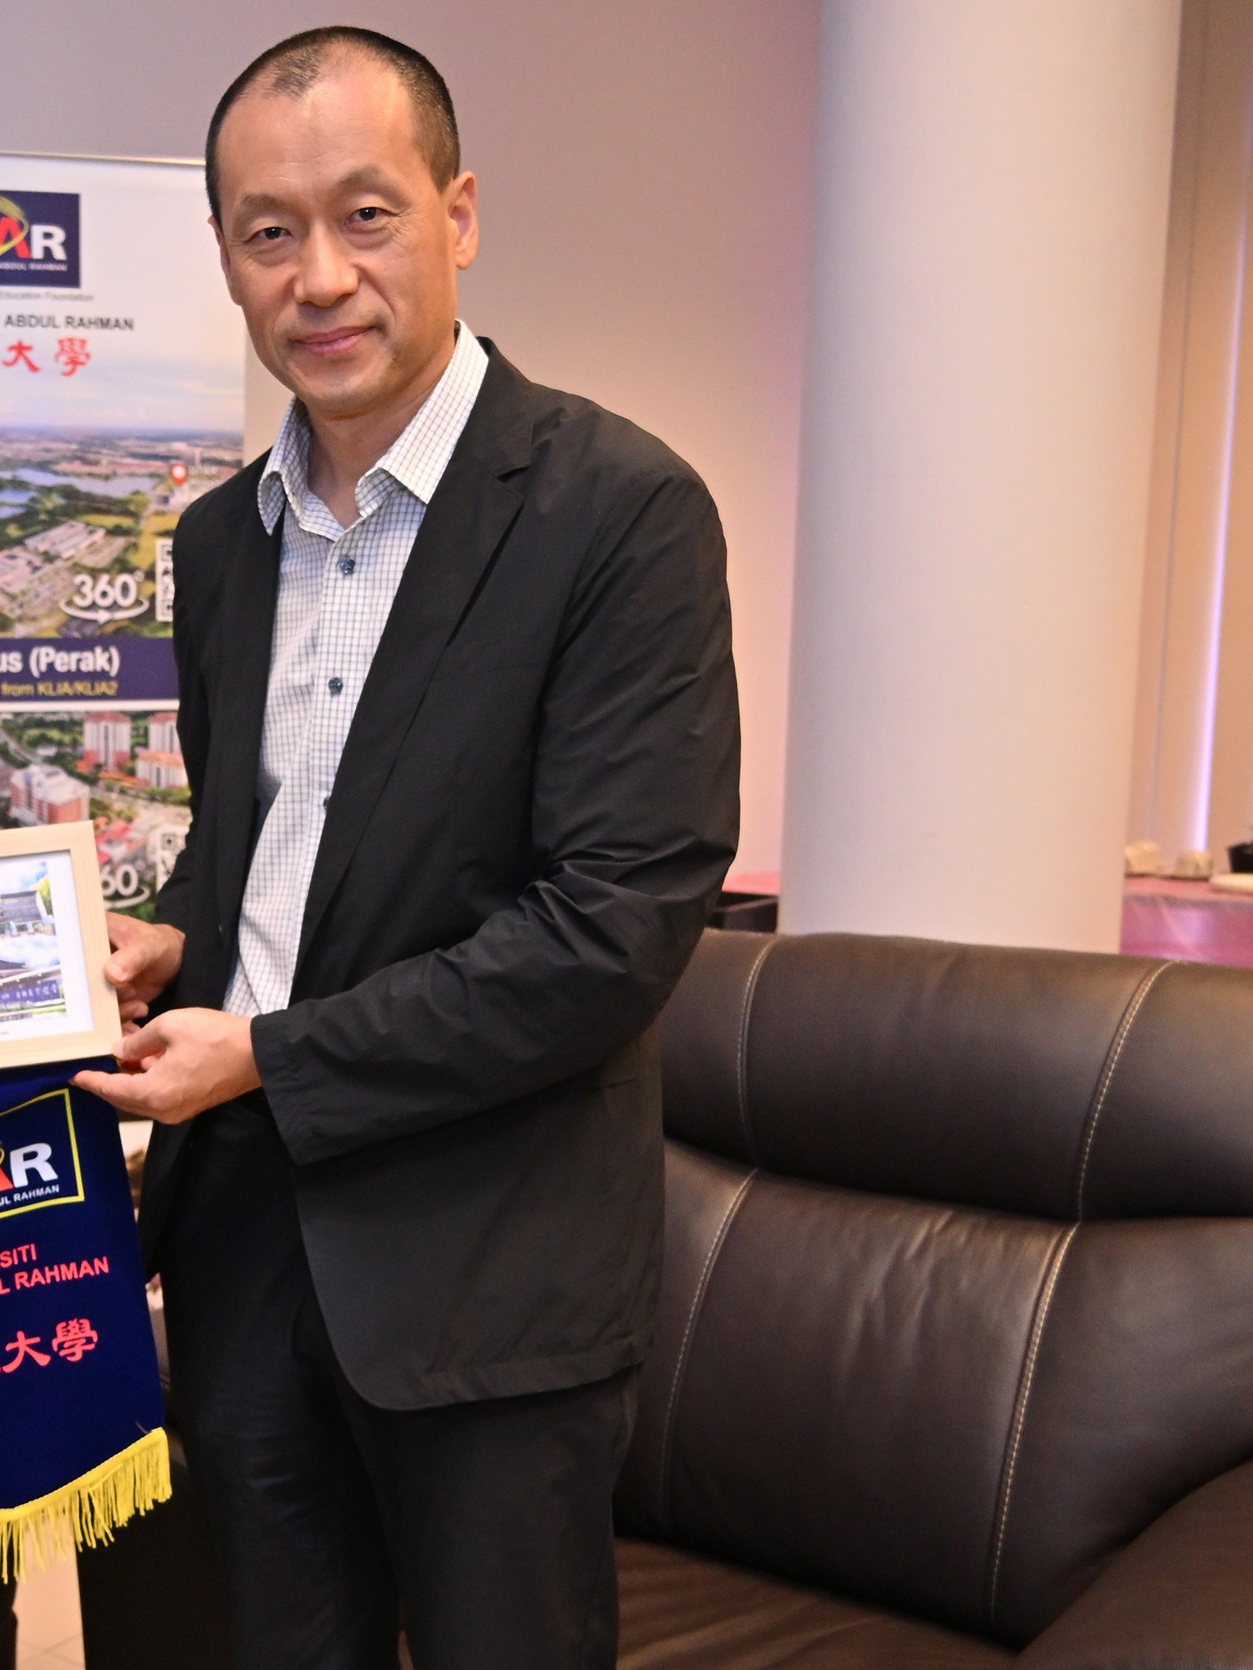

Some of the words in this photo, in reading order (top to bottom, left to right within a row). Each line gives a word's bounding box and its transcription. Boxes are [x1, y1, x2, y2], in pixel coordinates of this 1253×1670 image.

[4, 314, 59, 329] ABDUL
[64, 315, 134, 331] RAHMAN
[29, 645, 121, 677] (Perak)
[1, 682, 34, 697] from
[13, 1184, 60, 1202] RAHMAN
[14, 1256, 110, 1291] RAHMAN
